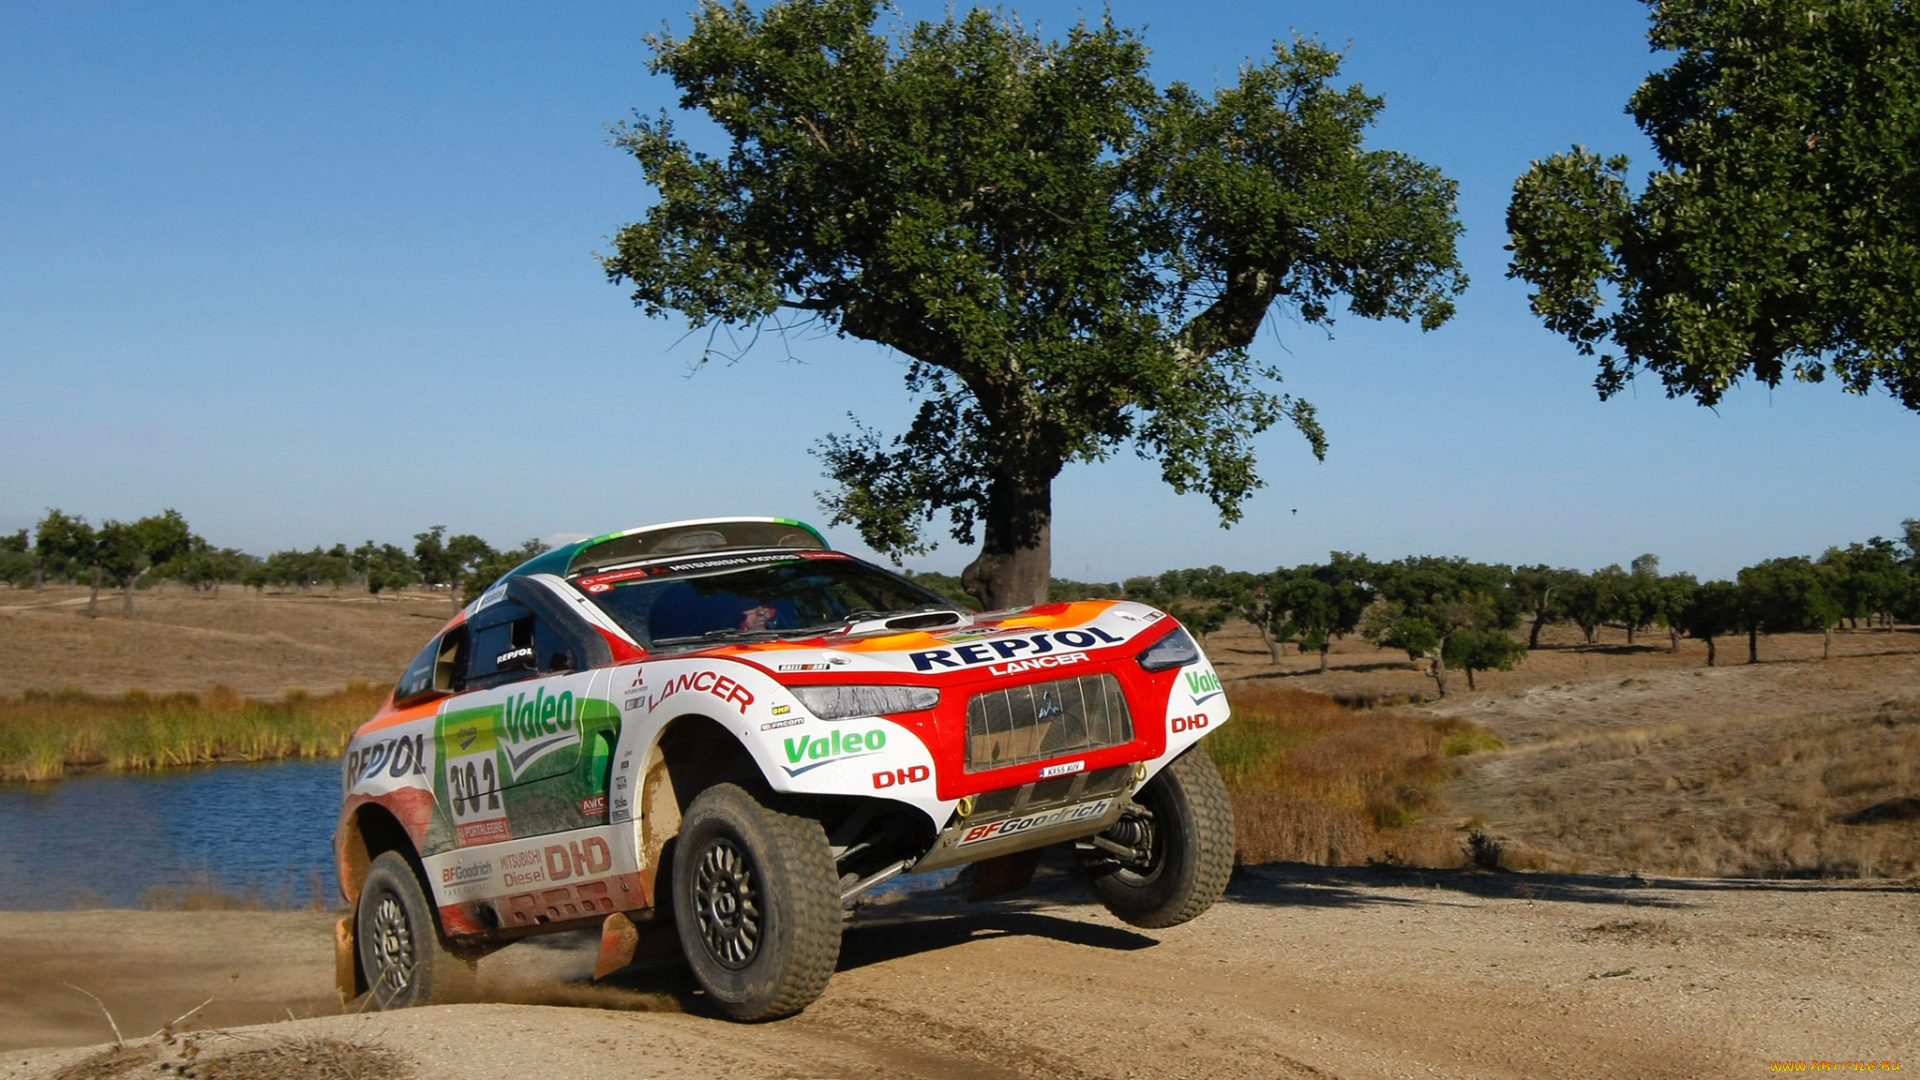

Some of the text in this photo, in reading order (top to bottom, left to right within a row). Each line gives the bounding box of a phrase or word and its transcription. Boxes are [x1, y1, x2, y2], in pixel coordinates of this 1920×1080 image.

[669, 558, 748, 571] MITSUBISHI
[747, 554, 800, 563] MOTORS
[496, 648, 533, 664] REPSOL
[909, 627, 1125, 671] REPSOL
[989, 651, 1090, 676] LANCER
[649, 671, 755, 715] LANCER
[506, 686, 573, 744] Valeo
[784, 729, 886, 763] Valeo
[347, 733, 427, 790] REPSOL
[450, 758, 500, 816] 302
[583, 797, 605, 810] AWC
[464, 821, 504, 837] PORTALEGRE
[964, 800, 1107, 842] BFGoodrich
[443, 861, 493, 882] BFGoodrich
[501, 849, 542, 870] MITSUBISHI
[503, 867, 546, 887] Diesel
